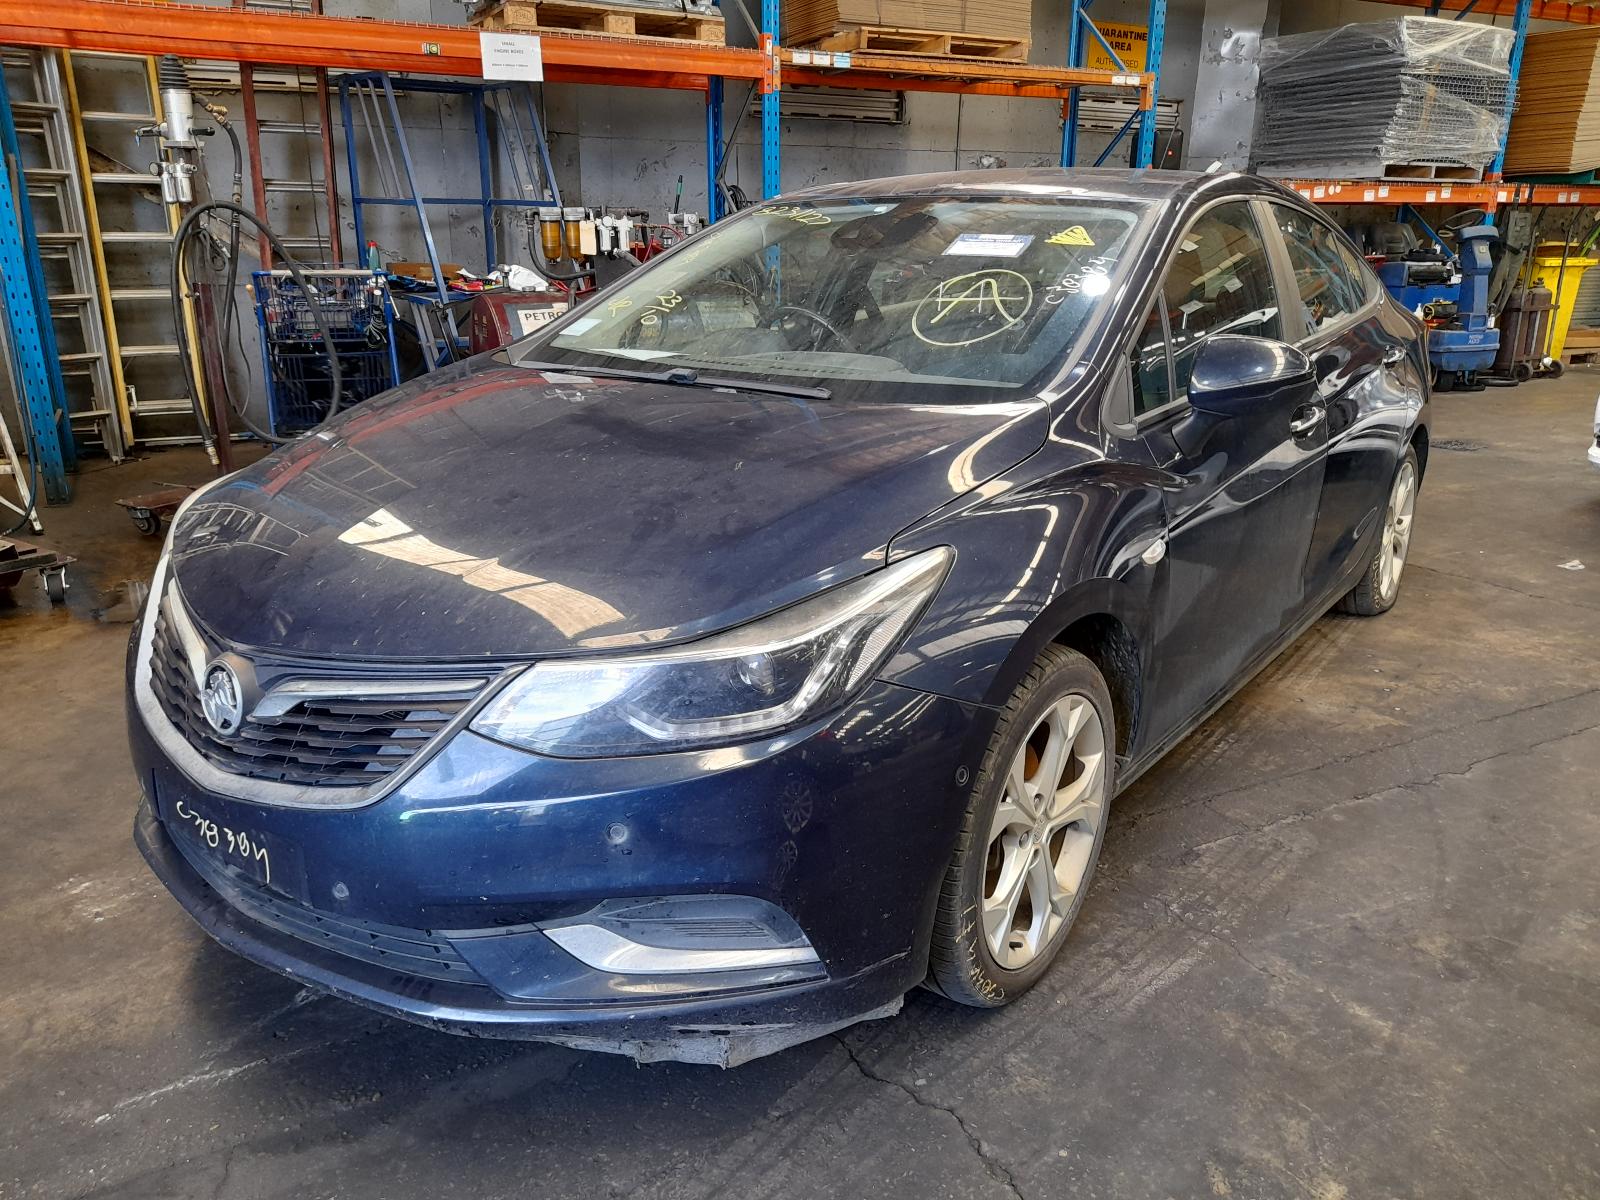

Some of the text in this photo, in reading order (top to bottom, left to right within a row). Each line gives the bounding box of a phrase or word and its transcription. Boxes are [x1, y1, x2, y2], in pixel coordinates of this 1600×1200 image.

[1098, 27, 1148, 42] UARANTINE
[1109, 41, 1132, 52] AREA
[524, 311, 566, 321] PETRO
